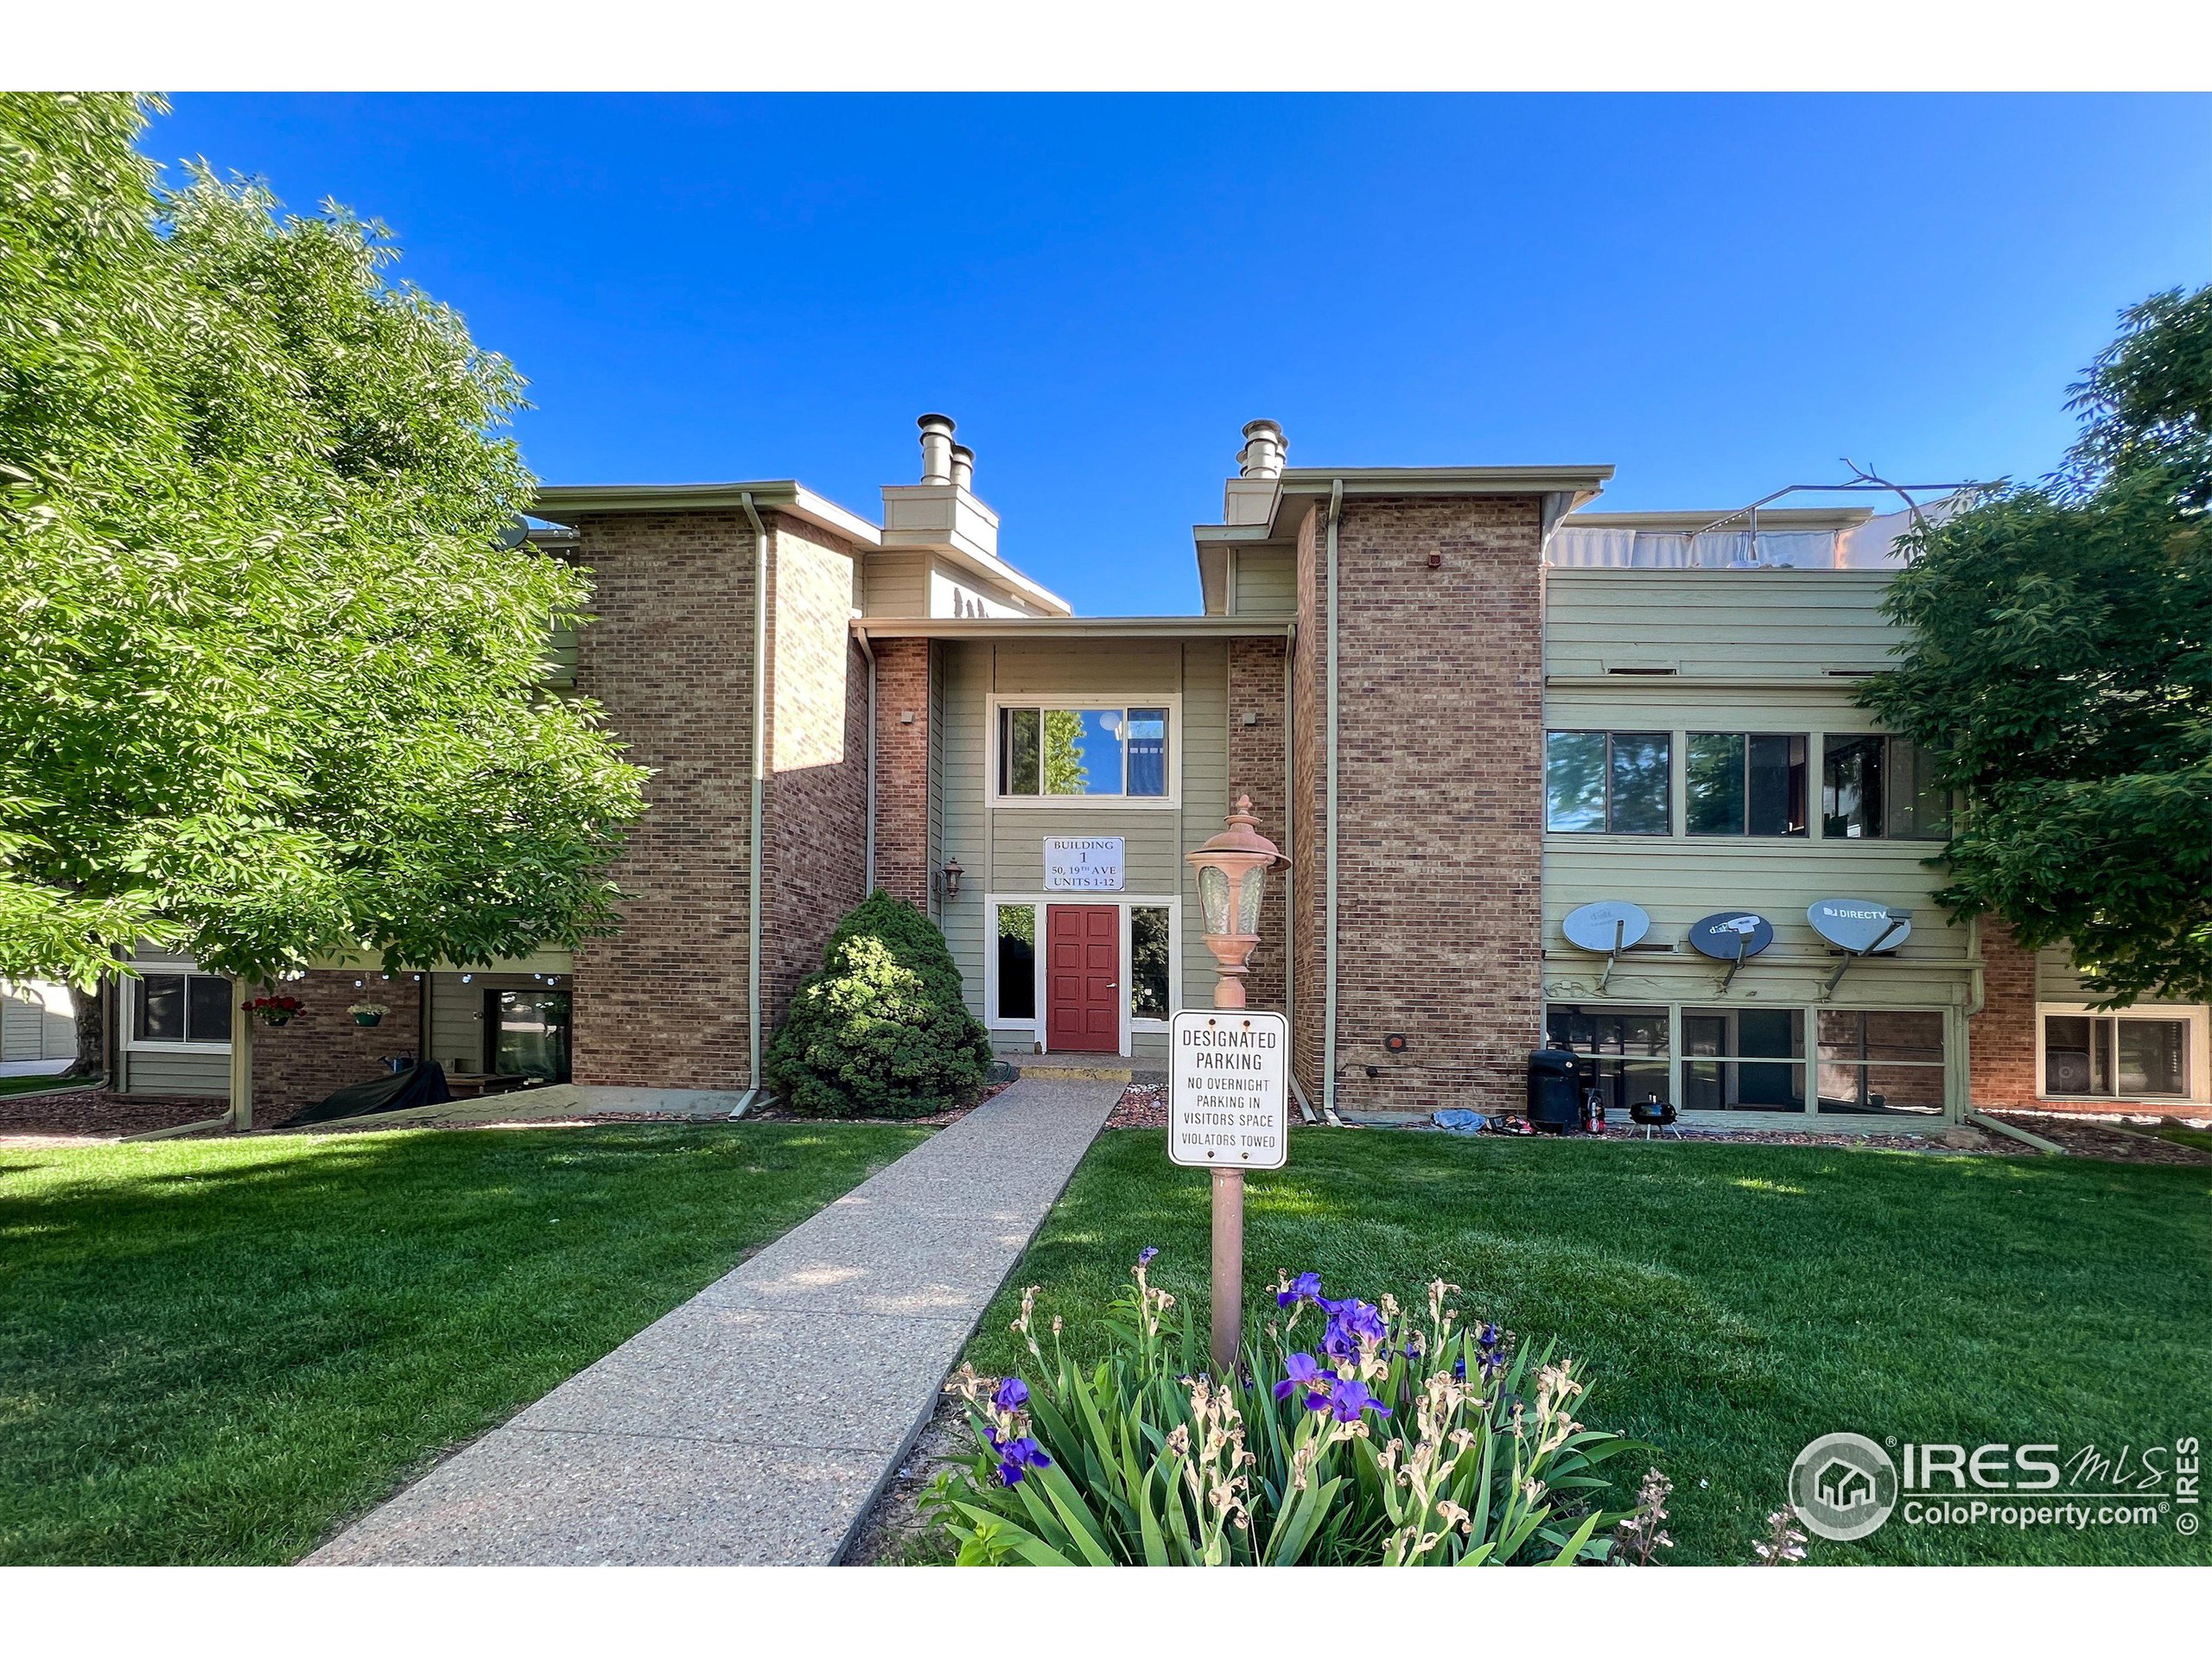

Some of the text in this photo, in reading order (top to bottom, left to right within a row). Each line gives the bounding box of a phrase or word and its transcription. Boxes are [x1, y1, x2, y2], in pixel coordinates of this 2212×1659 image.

[1079, 852, 1087, 863] 1
[1052, 866, 1066, 875] 50,
[1091, 866, 1116, 874] AVE
[1054, 878, 1115, 887] UNITS 1-12
[1840, 909, 1886, 919] DIRECTV
[1183, 1030, 1276, 1049] DESIGNATED
[1196, 1052, 1262, 1071] PARKING
[1187, 1077, 1270, 1092] NO OVERNIGHT
[1197, 1096, 1261, 1109] PARKING IN
[1184, 1113, 1274, 1128] VISITORS SPACE
[1182, 1133, 1275, 1148] VIOLATORS TOWED
